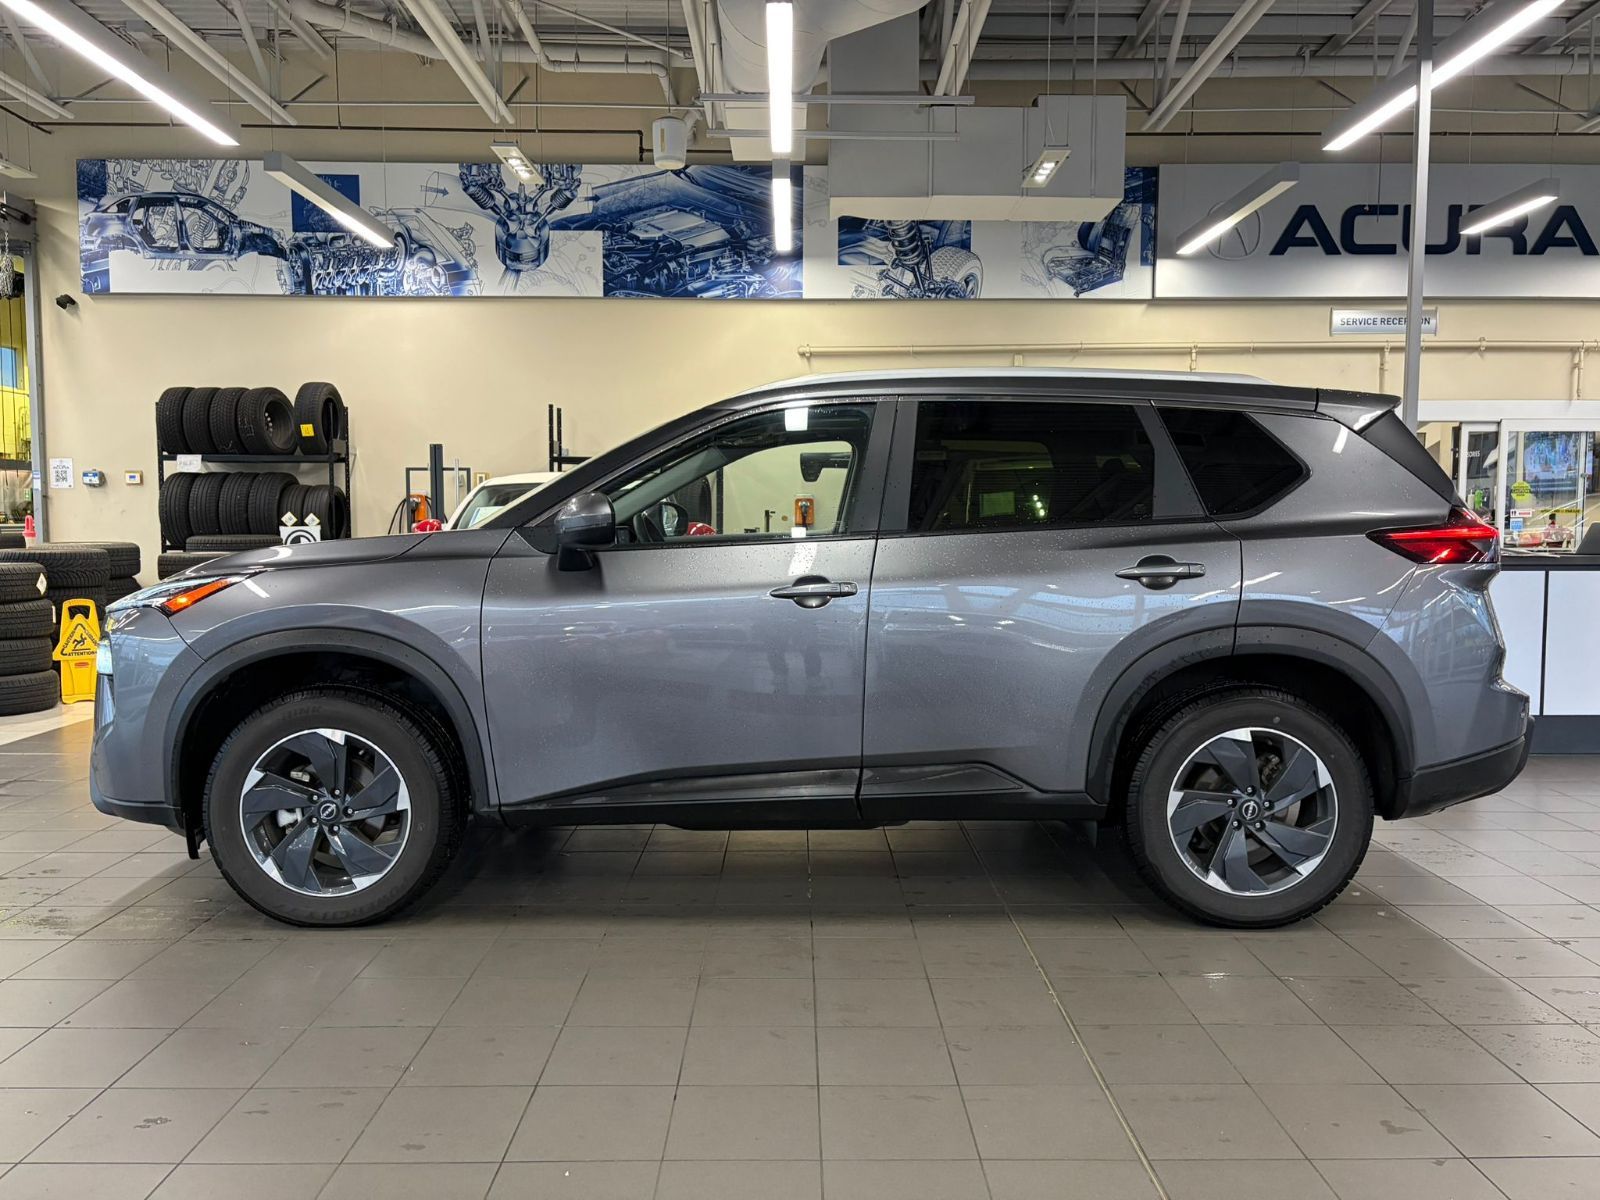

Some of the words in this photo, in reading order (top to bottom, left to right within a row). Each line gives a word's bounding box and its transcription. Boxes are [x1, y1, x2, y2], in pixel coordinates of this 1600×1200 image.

[1269, 204, 1600, 255] ACURA
[1340, 317, 1378, 326] SERVICE
[63, 630, 76, 648] CAUTION
